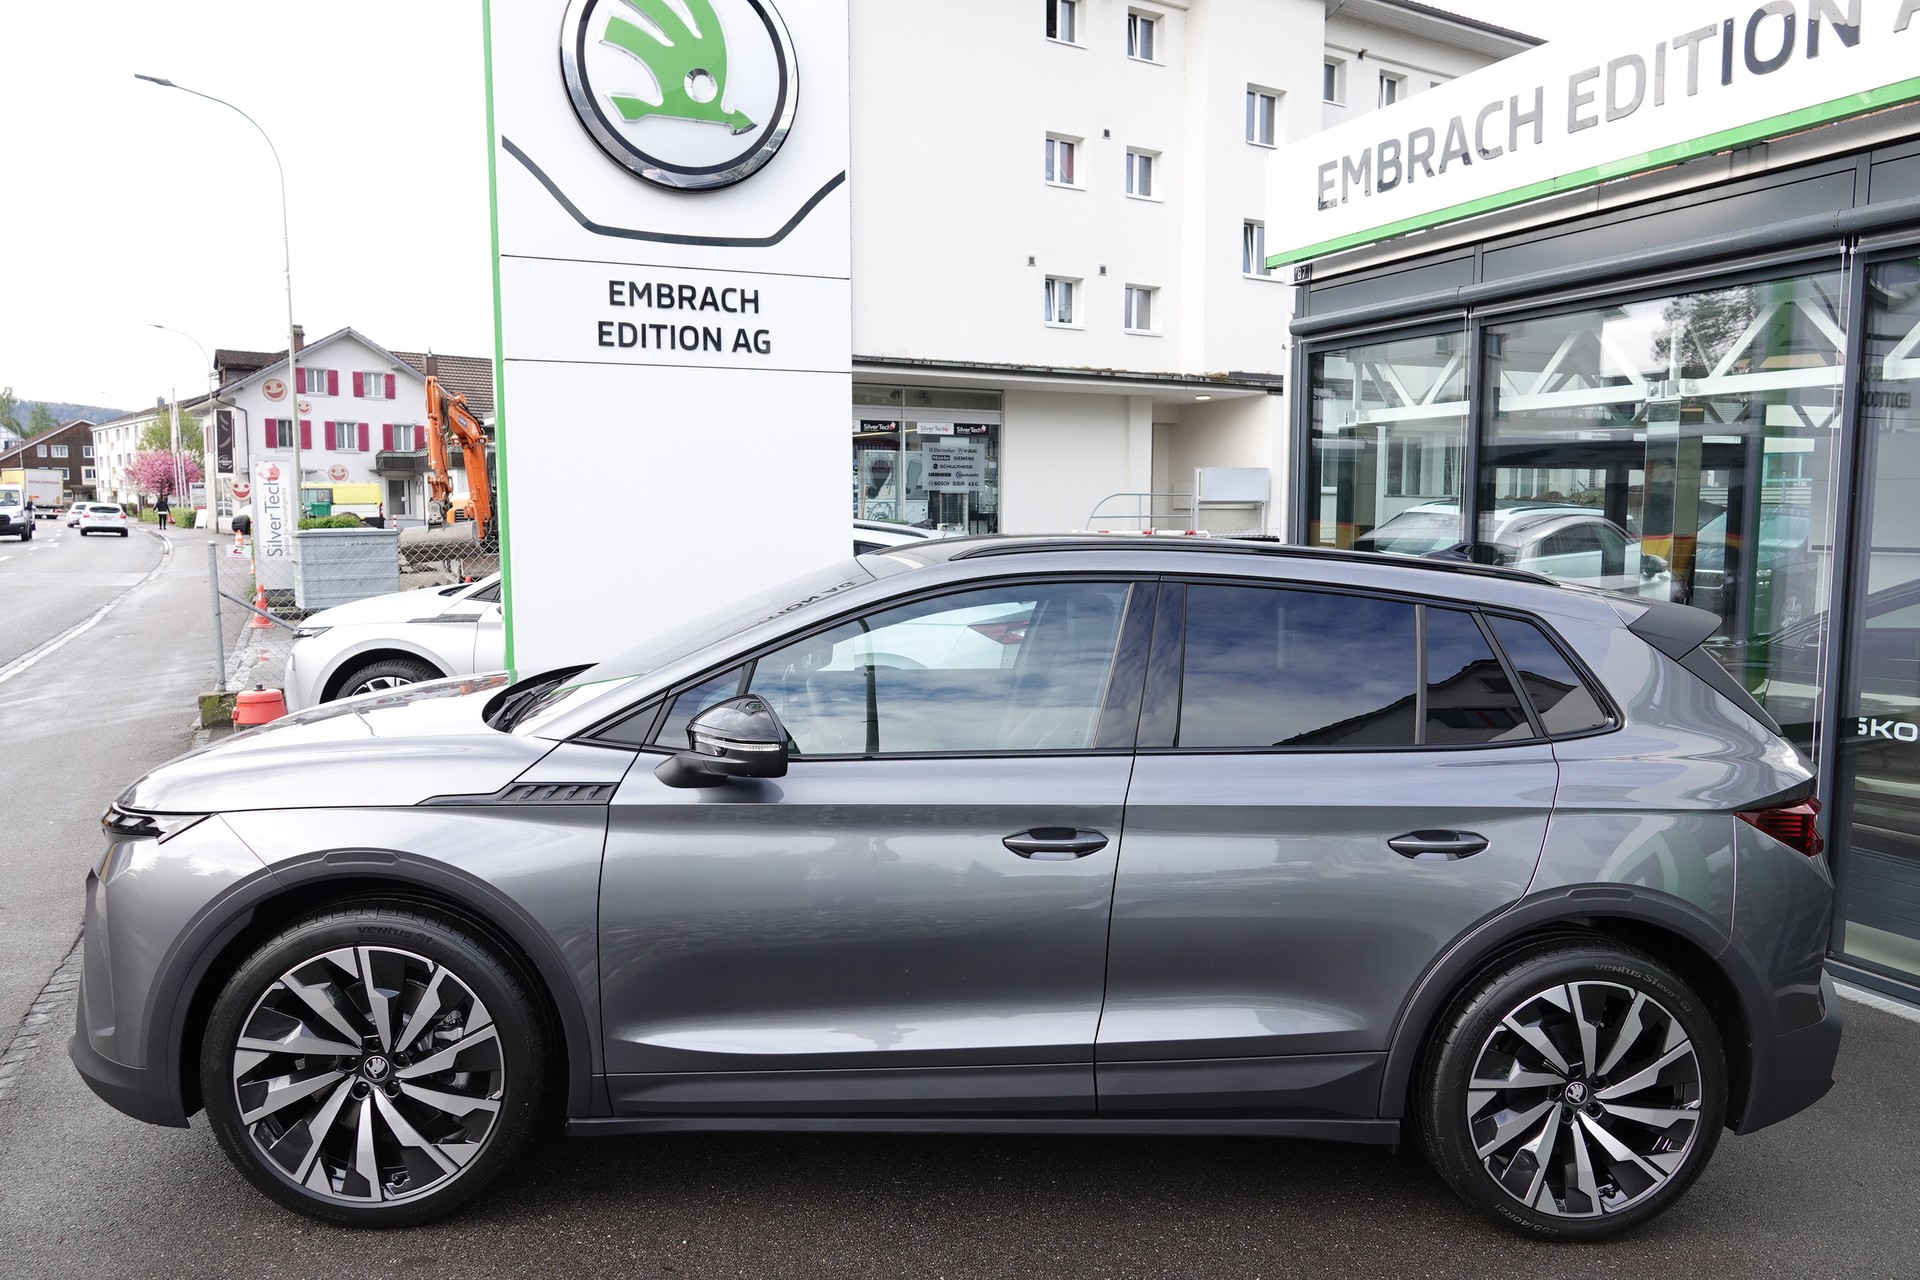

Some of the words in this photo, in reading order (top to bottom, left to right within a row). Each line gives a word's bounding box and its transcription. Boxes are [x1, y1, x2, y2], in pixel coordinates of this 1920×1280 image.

[1318, 85, 1543, 211] EMBRACH
[1567, 0, 1861, 134] EDITION
[608, 280, 760, 314] EMBRACH
[597, 320, 722, 352] EDITION
[731, 328, 771, 354] AG
